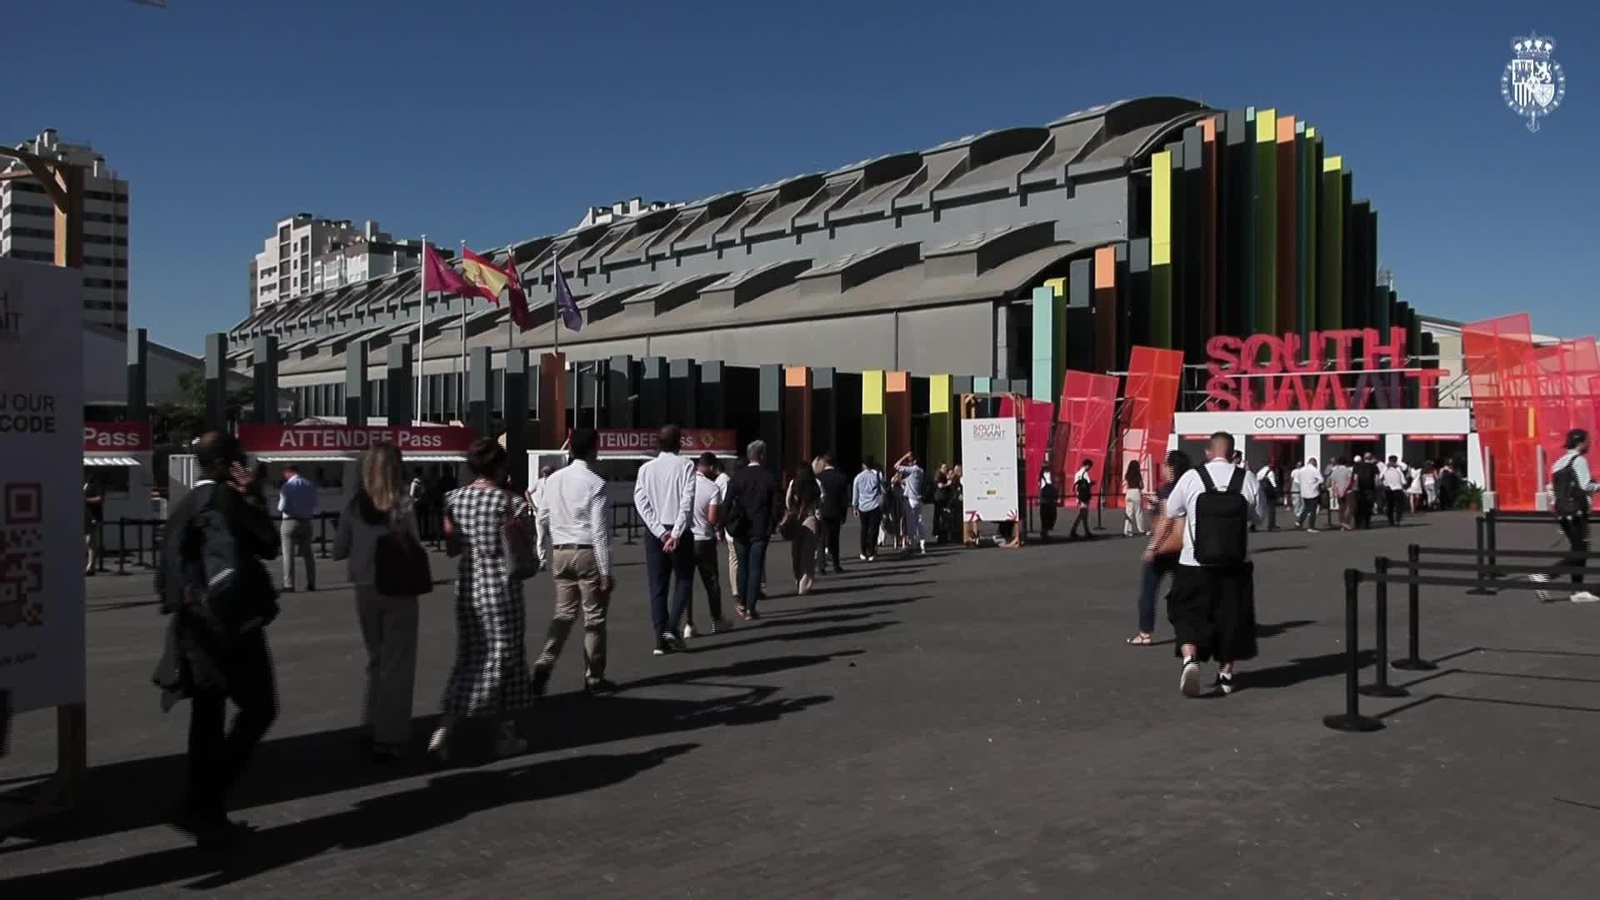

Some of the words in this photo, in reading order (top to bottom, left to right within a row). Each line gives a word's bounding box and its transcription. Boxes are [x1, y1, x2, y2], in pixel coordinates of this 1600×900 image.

[1206, 327, 1407, 373] SOUTH
[13, 393, 55, 412] OUR
[0, 415, 56, 434] CODE
[1254, 414, 1370, 432] convergence
[83, 427, 141, 447] Pass
[398, 431, 442, 447] Pass
